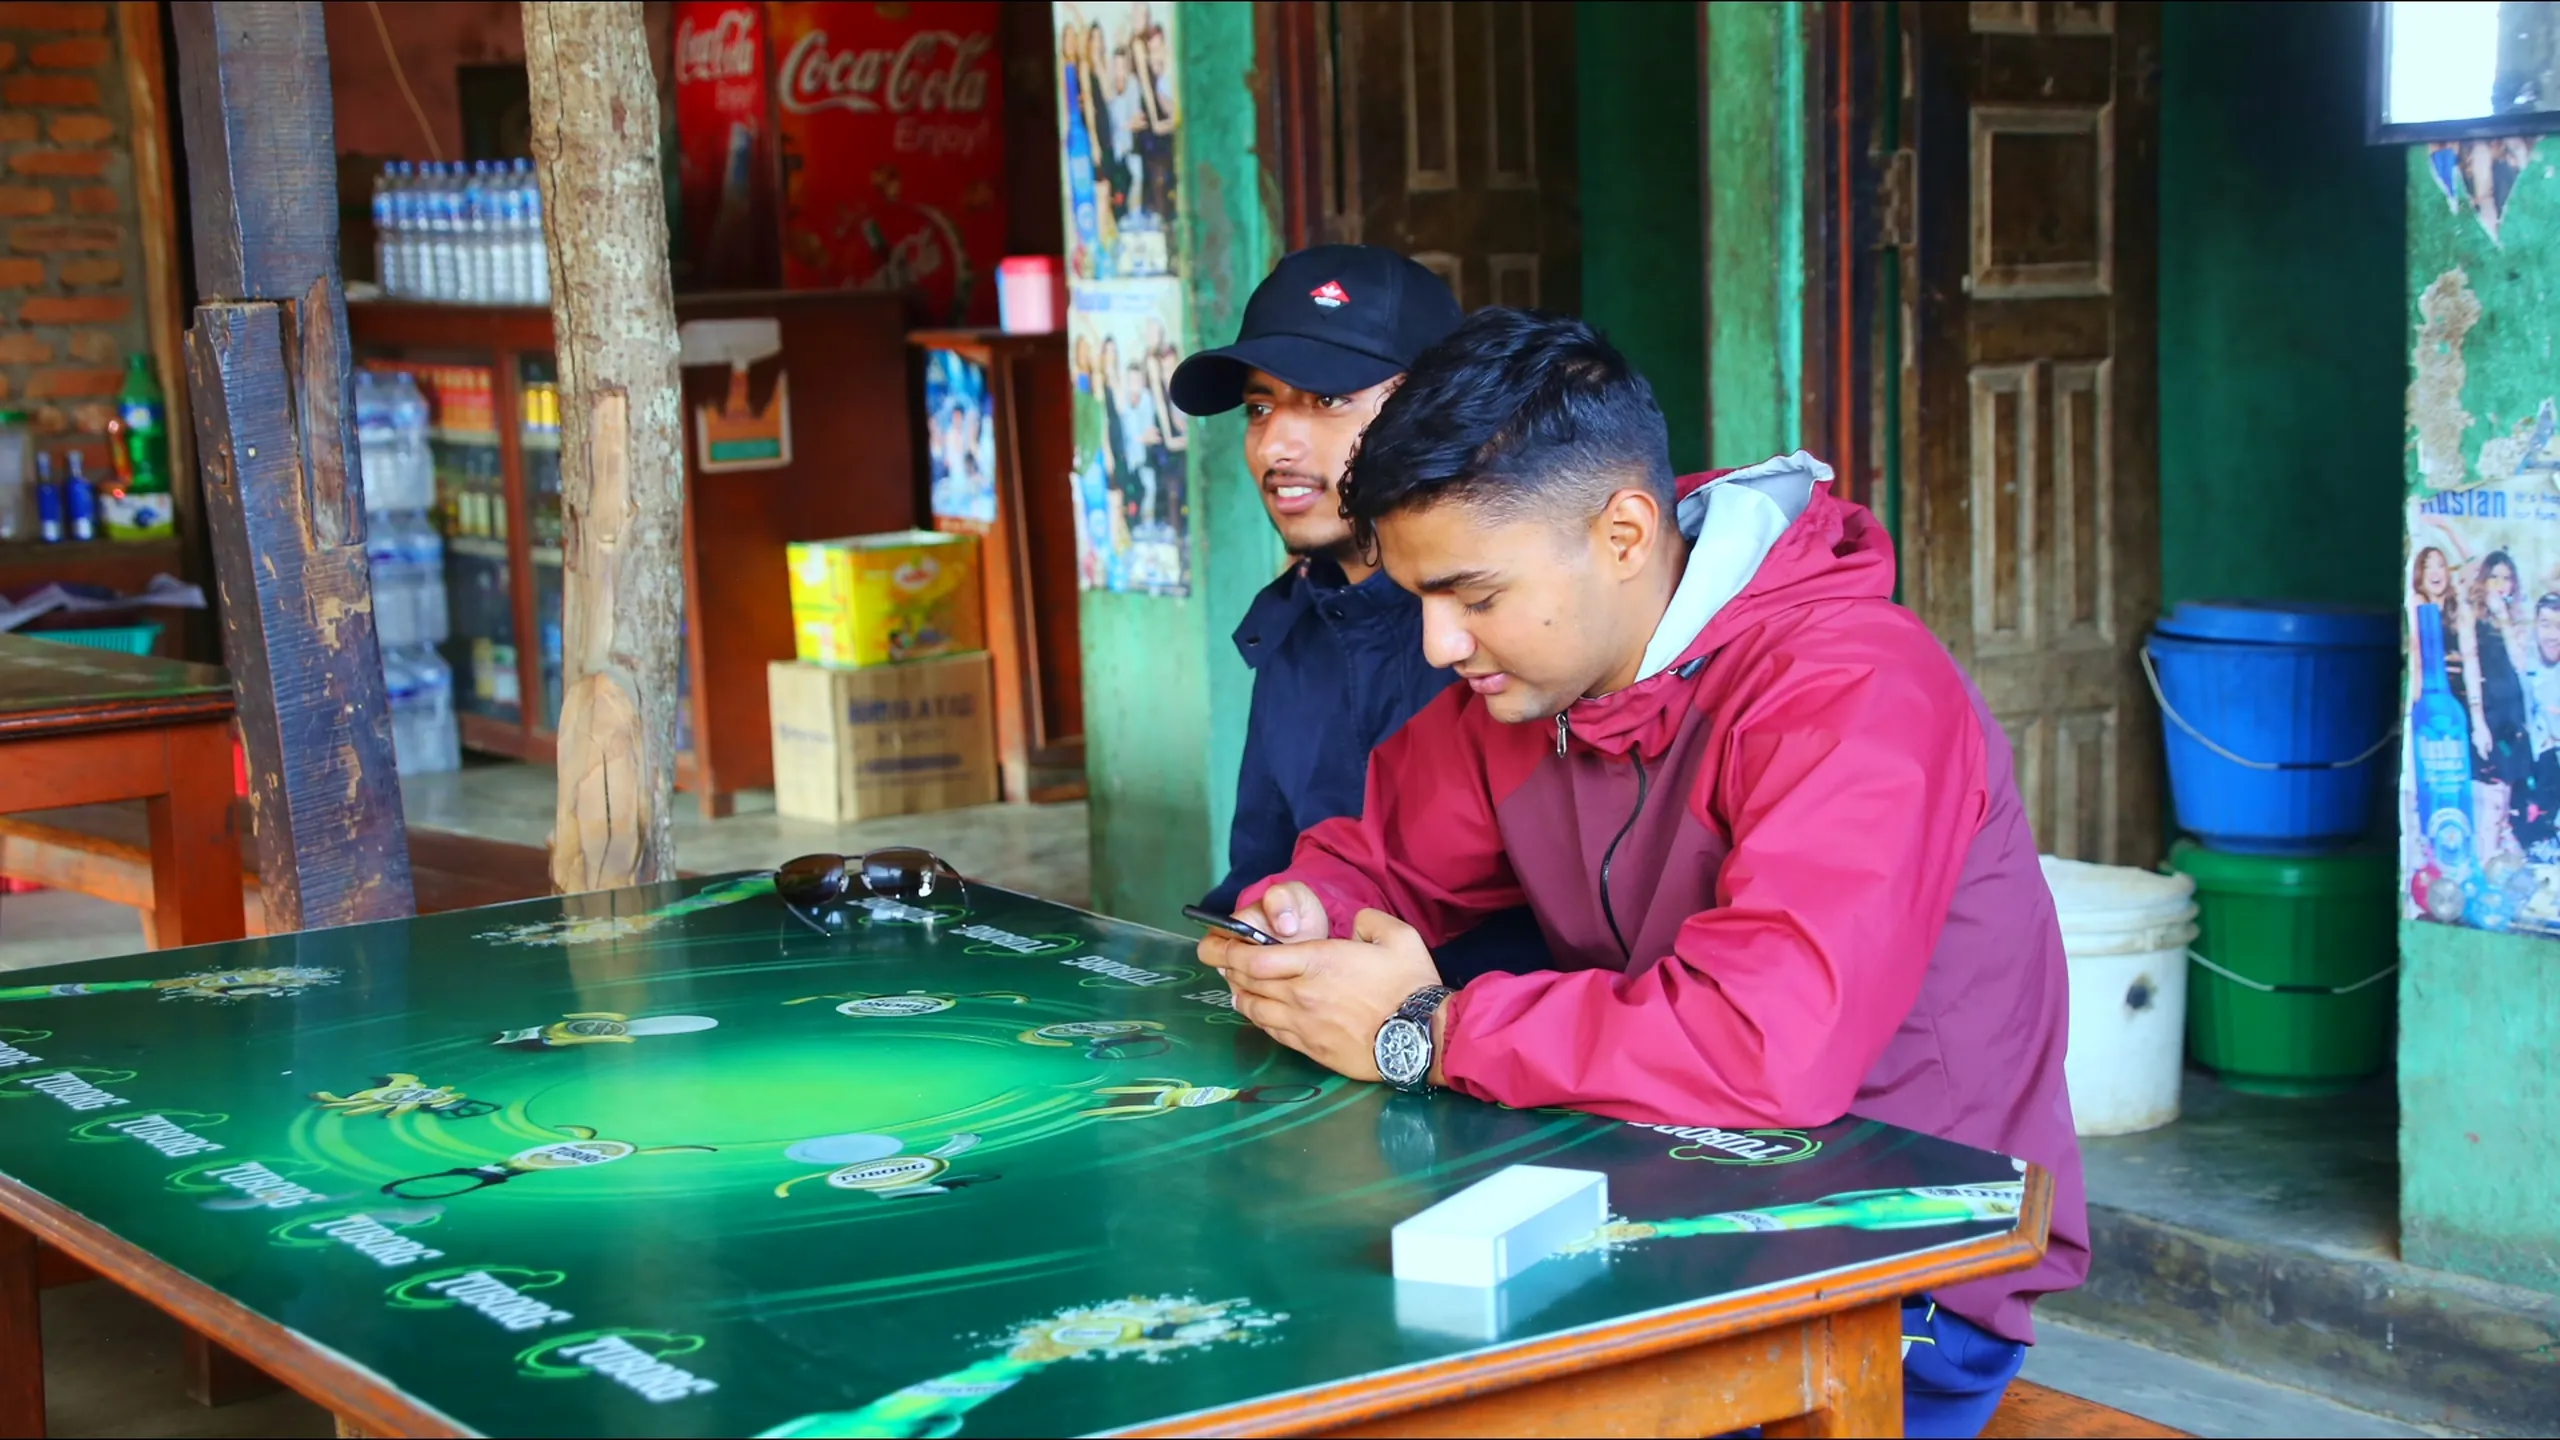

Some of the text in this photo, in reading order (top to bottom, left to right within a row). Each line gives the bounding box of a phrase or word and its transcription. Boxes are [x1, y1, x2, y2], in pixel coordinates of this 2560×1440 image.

[1059, 955, 1178, 987] TUBORG
[20, 1071, 131, 1111] TUBORG
[107, 1114, 226, 1158] TUBORG
[203, 1161, 328, 1209] TUBORG
[836, 1162, 926, 1182] TUBORG
[309, 1213, 446, 1267] TUBORG
[426, 1271, 575, 1331] TUBORG
[557, 1335, 720, 1402] TUBORG
